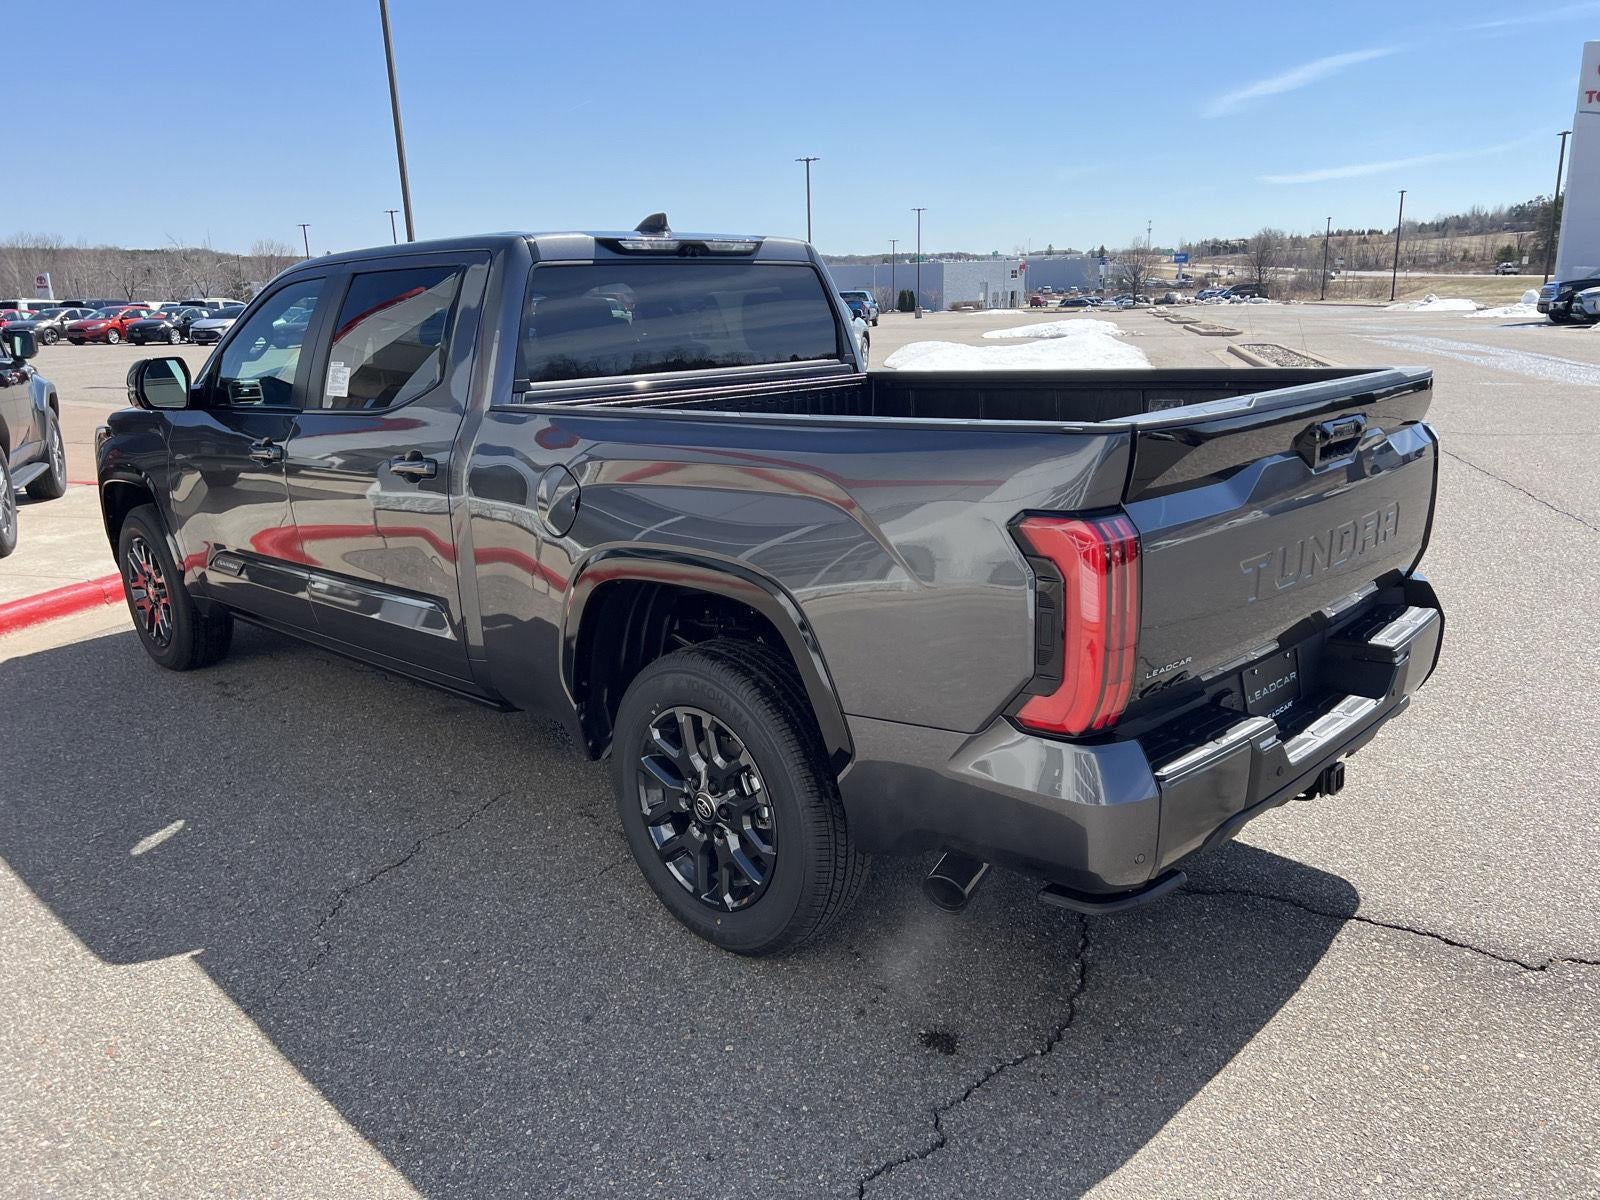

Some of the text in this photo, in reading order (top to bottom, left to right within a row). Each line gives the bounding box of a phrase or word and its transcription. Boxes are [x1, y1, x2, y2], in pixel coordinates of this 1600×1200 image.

[1240, 501, 1400, 602] TUNDRA
[1145, 656, 1193, 679] LEADCAR
[1248, 671, 1297, 704] LEADCAR
[685, 678, 752, 733] YOKOHAMA
[1267, 700, 1293, 719] EADCAR
